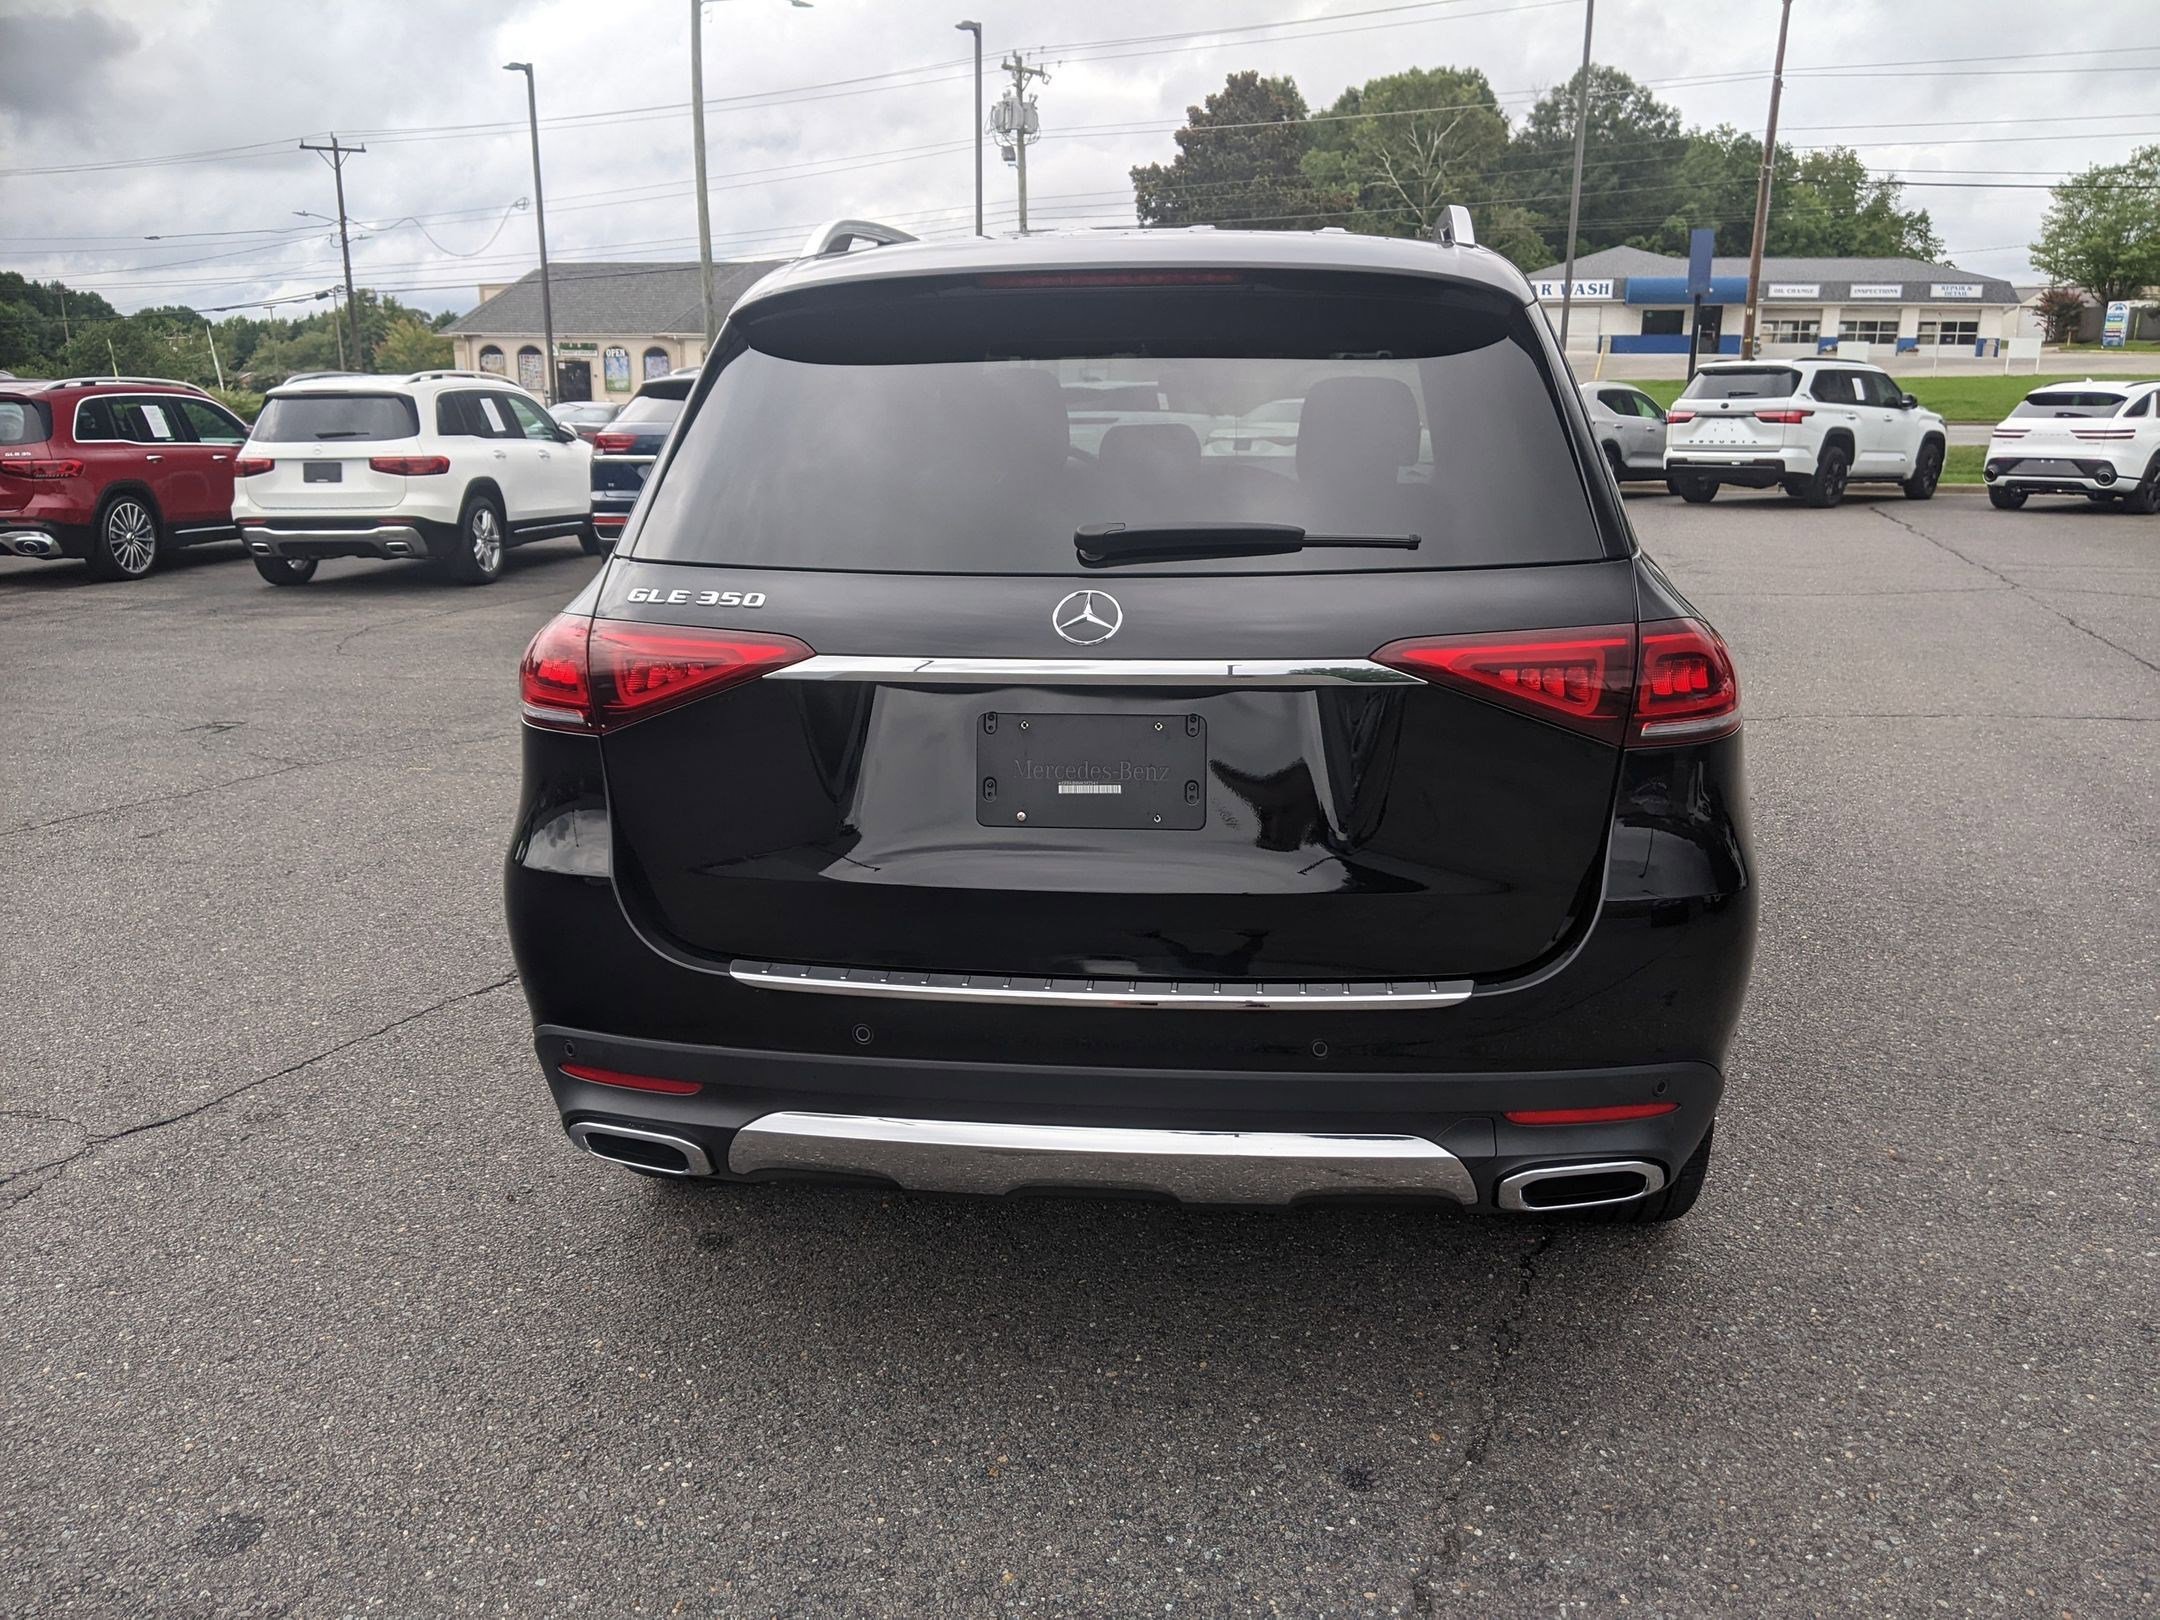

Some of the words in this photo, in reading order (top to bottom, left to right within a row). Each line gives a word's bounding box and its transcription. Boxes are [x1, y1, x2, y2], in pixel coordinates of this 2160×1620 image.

[606, 348, 625, 357] OPEN
[627, 588, 692, 605] GLE
[695, 590, 766, 608] 350
[1014, 758, 1170, 782] Mercedes-Benz
